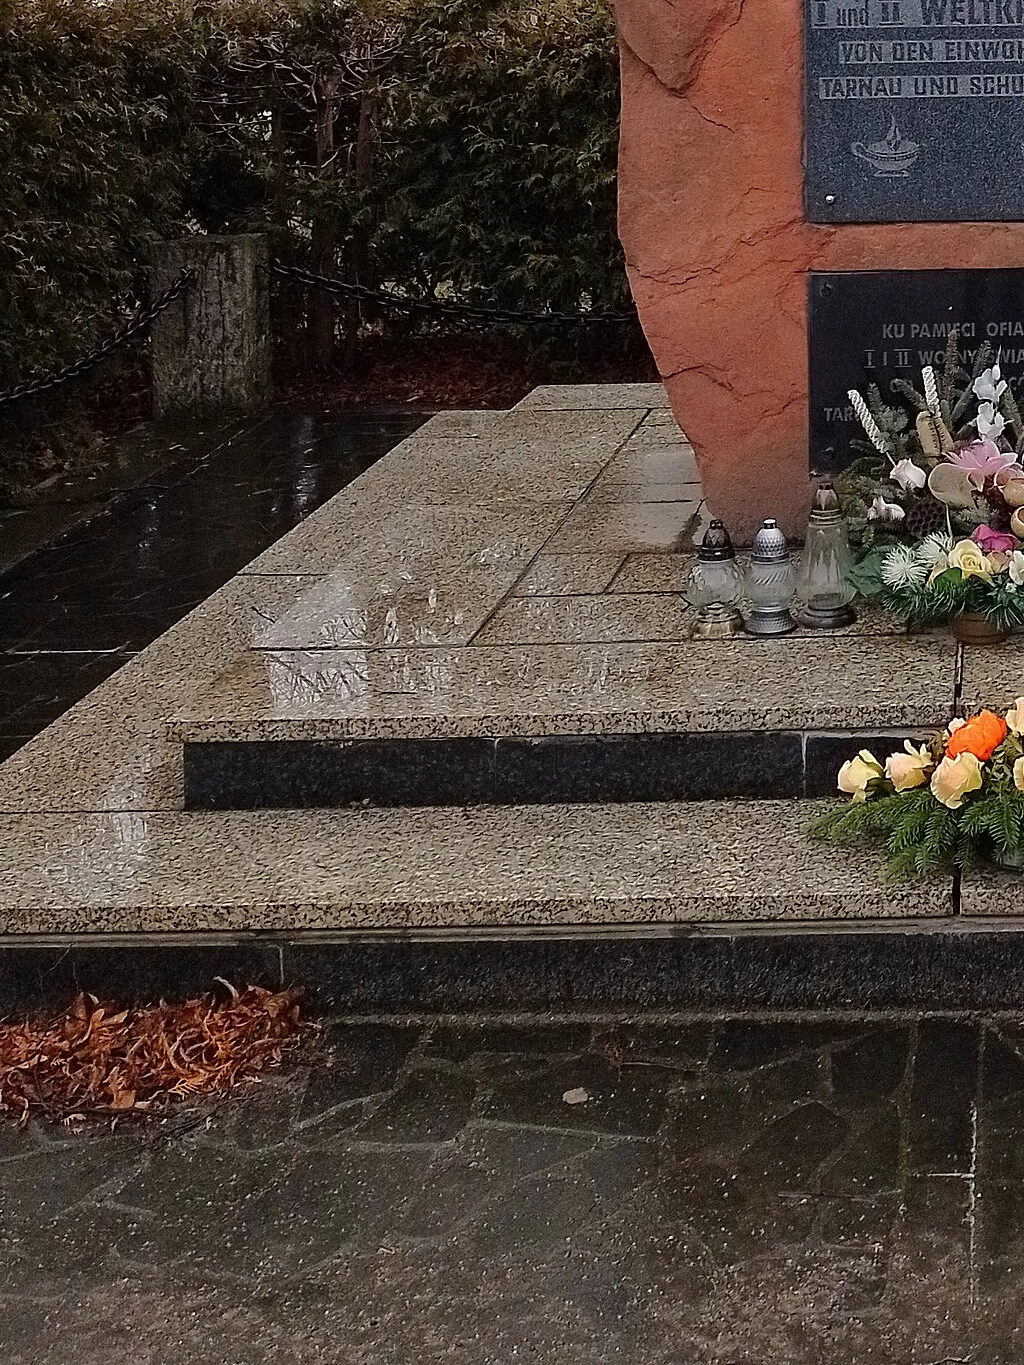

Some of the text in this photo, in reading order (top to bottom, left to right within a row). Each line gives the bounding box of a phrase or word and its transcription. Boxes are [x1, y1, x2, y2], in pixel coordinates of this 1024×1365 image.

[836, 0, 869, 27] und
[840, 42, 883, 63] VON
[891, 41, 934, 62] DEN
[823, 76, 902, 98] TARNAU
[914, 75, 959, 96] UND
[882, 323, 905, 339] KU
[917, 349, 978, 366] WONY
